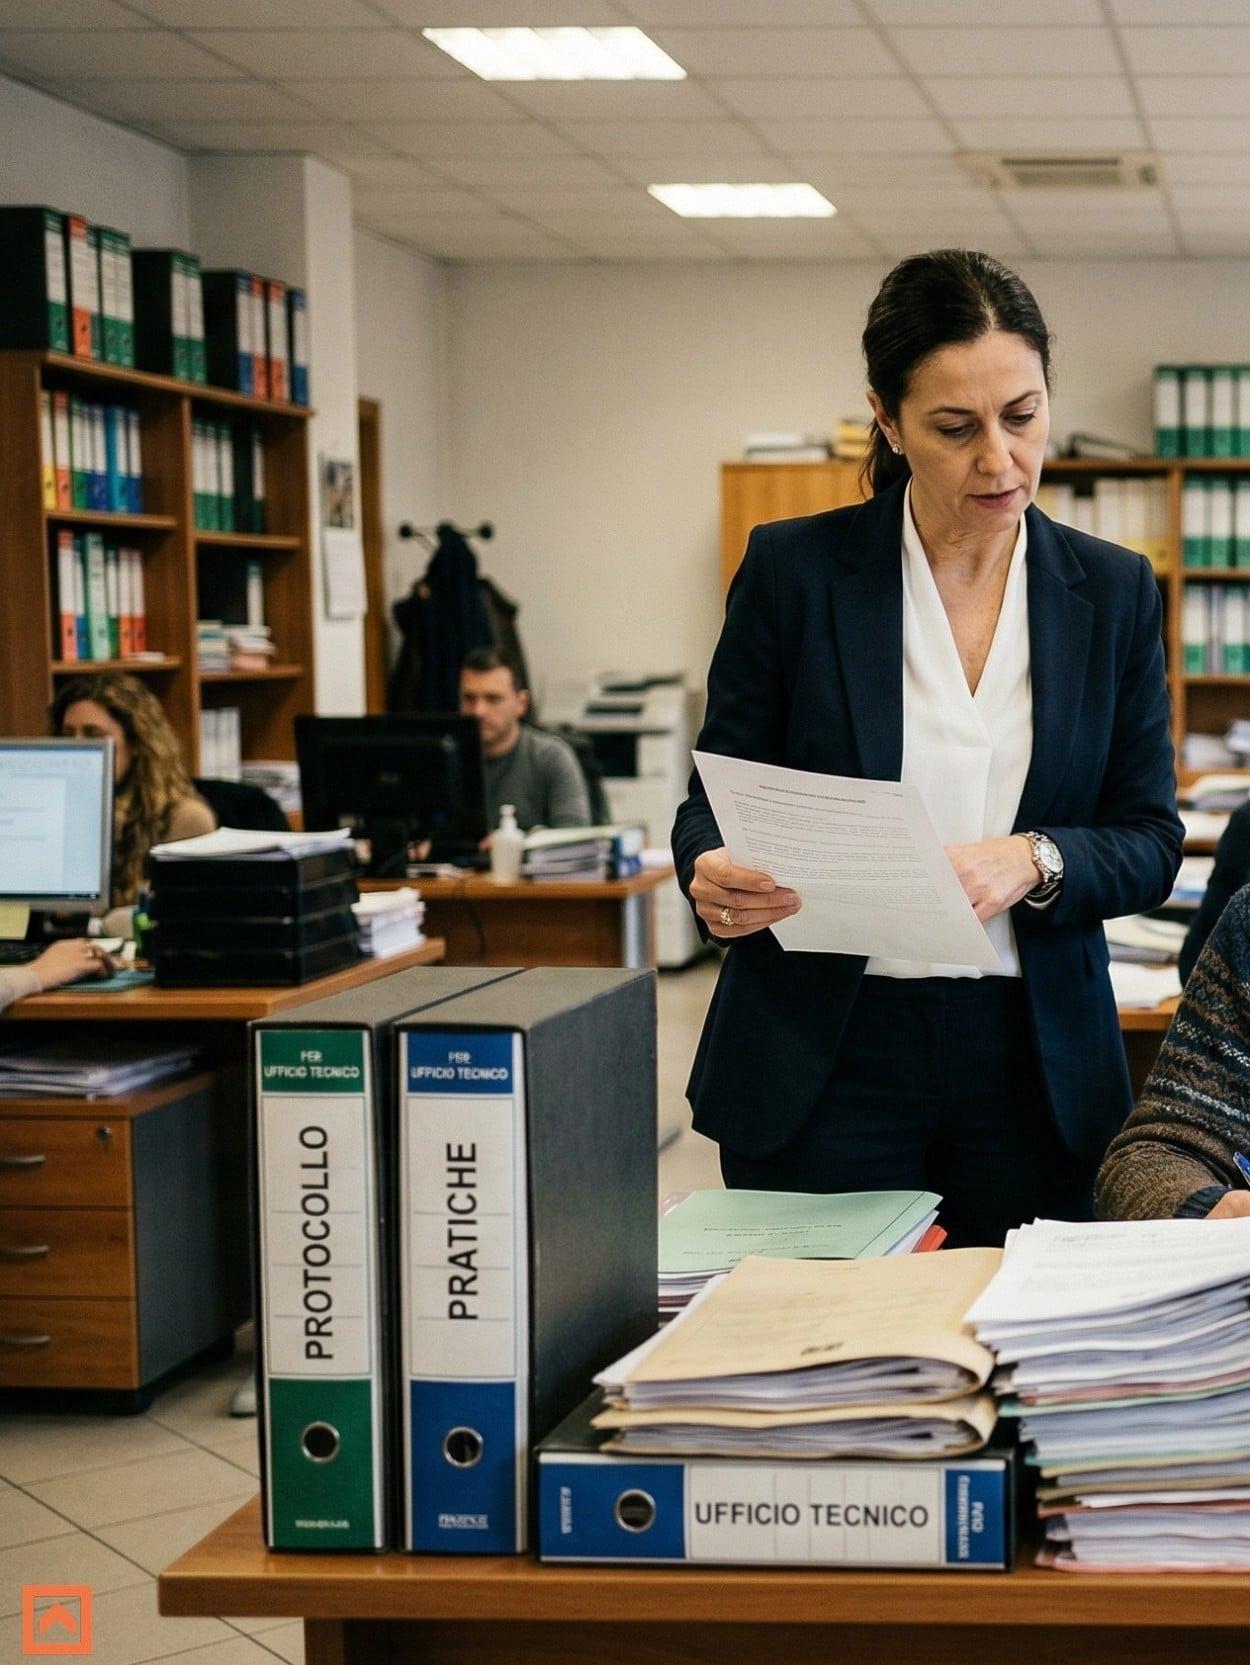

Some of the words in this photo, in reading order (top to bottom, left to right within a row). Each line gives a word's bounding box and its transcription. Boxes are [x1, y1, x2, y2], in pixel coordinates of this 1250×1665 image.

[299, 1126, 333, 1359] PROTOCOLLO
[447, 1143, 478, 1320] PRATICHE
[695, 1503, 800, 1526] UFFICIO
[810, 1504, 929, 1528] TECNICO
